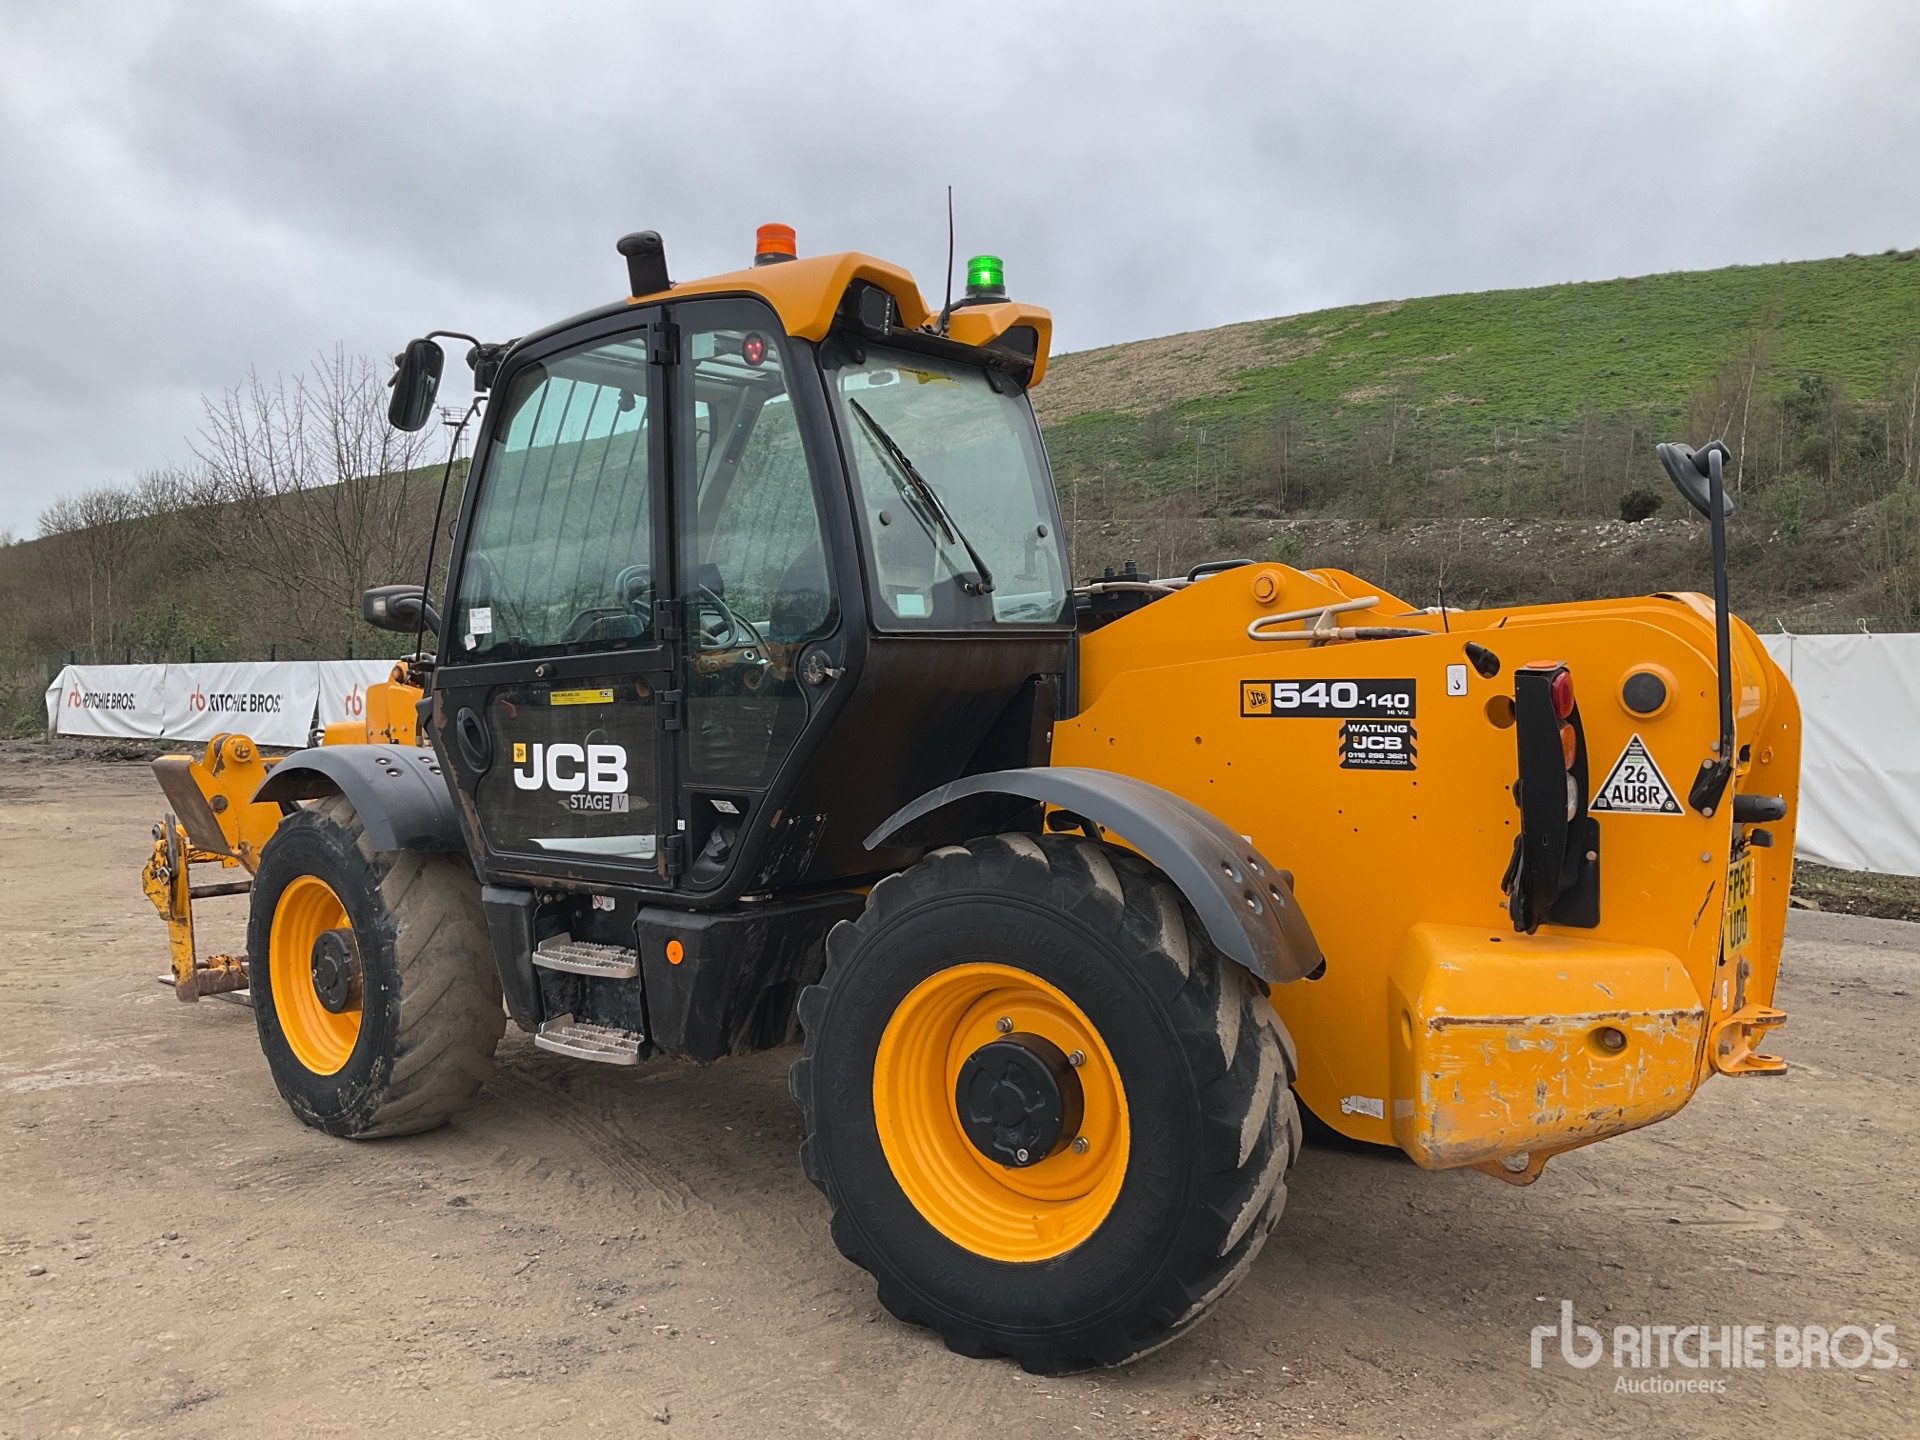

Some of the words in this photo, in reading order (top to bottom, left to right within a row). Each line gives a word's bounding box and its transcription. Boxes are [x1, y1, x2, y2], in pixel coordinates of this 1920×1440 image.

[208, 693, 247, 712] RITCHIE
[1250, 691, 1267, 706] JCB
[1273, 682, 1410, 709] 540-140
[1347, 724, 1408, 733] WATLING
[1352, 735, 1402, 750] JCB
[513, 742, 629, 793] JCB
[1623, 765, 1648, 784] 26
[570, 793, 611, 810] STAGE
[1611, 784, 1661, 805] AU8R
[1728, 860, 1751, 908] FP69
